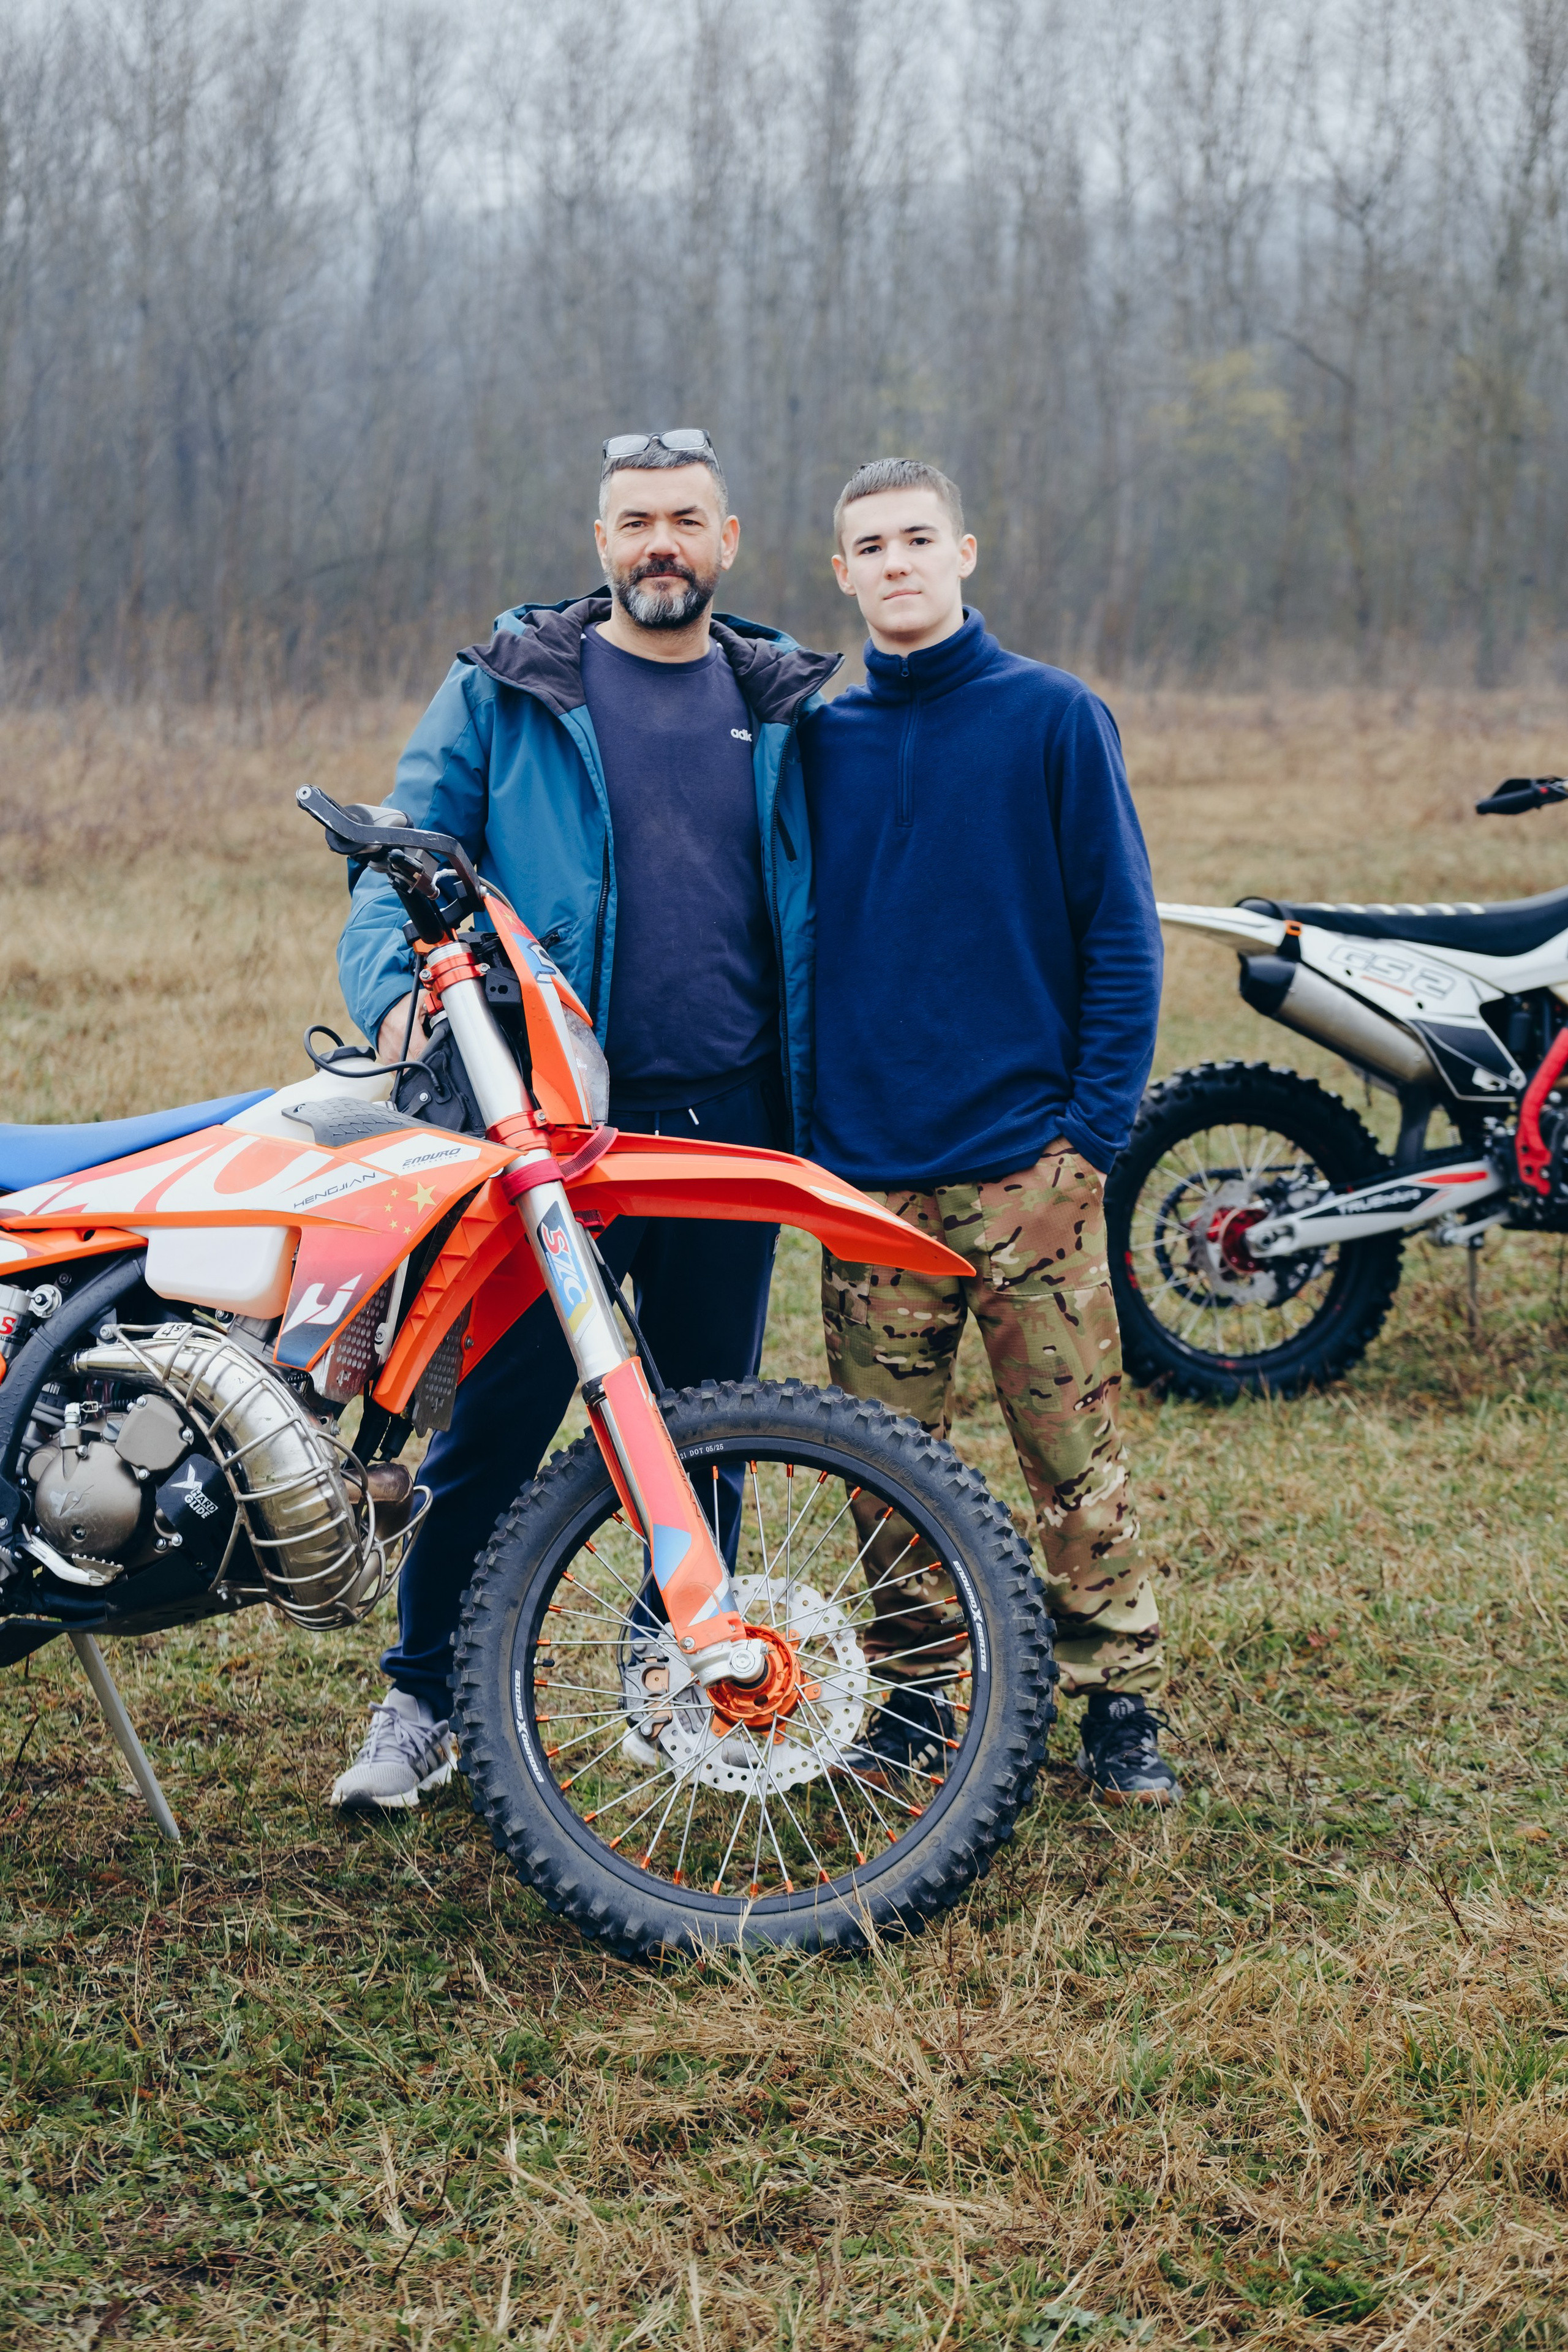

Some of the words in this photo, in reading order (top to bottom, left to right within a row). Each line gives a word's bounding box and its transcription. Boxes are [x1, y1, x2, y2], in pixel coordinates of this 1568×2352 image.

[1327, 943, 1457, 1001] GS2
[402, 1148, 461, 1167] ENDURO
[293, 1172, 375, 1209] HENGJIAN
[540, 1221, 588, 1306] SZC
[689, 1447, 704, 1457] DOT
[706, 1443, 724, 1453] 05/25
[184, 1494, 211, 1519] GLIDE
[193, 1489, 216, 1511] HARD
